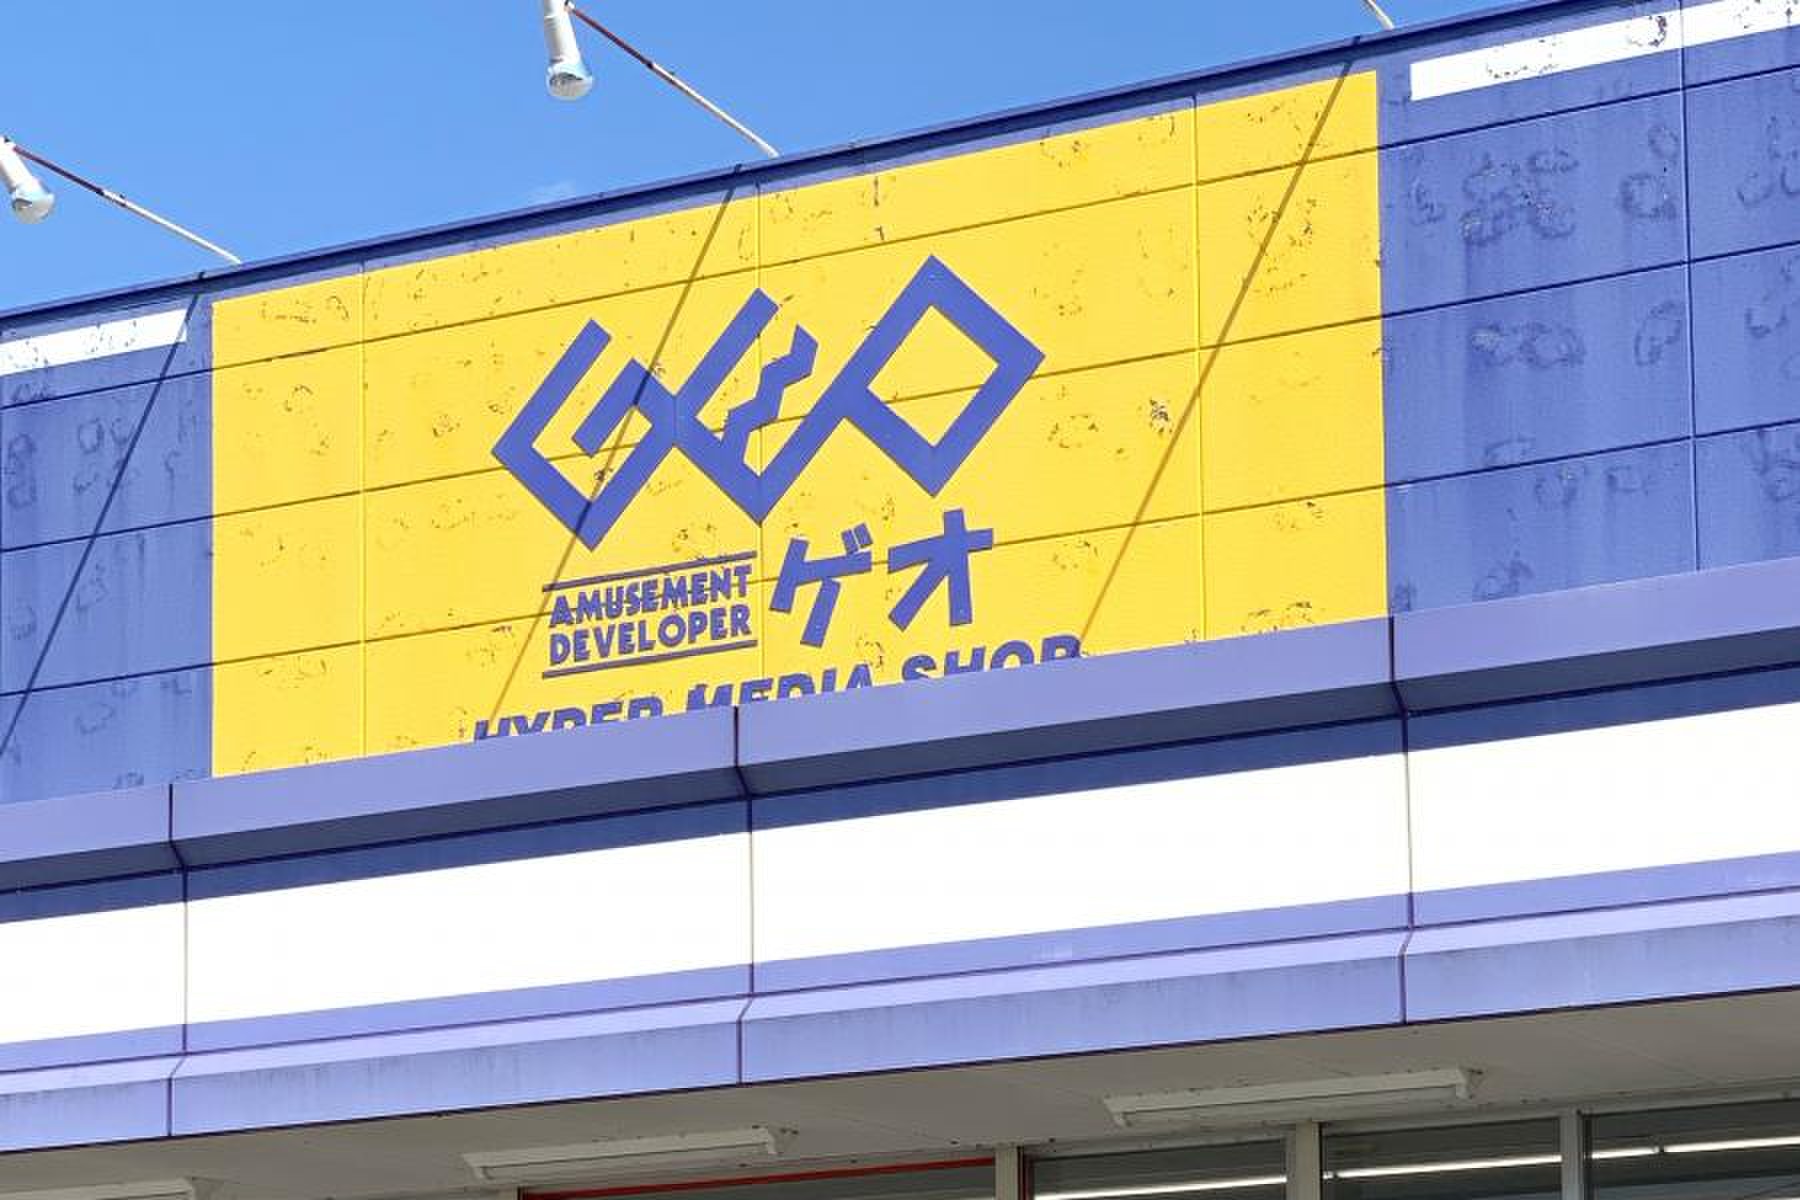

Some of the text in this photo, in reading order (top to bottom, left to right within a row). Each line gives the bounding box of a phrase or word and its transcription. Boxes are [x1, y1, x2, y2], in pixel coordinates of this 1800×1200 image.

[549, 564, 753, 627] AMUSEMENT
[769, 508, 993, 648] ゲオ
[549, 604, 752, 665] DEVELOPER
